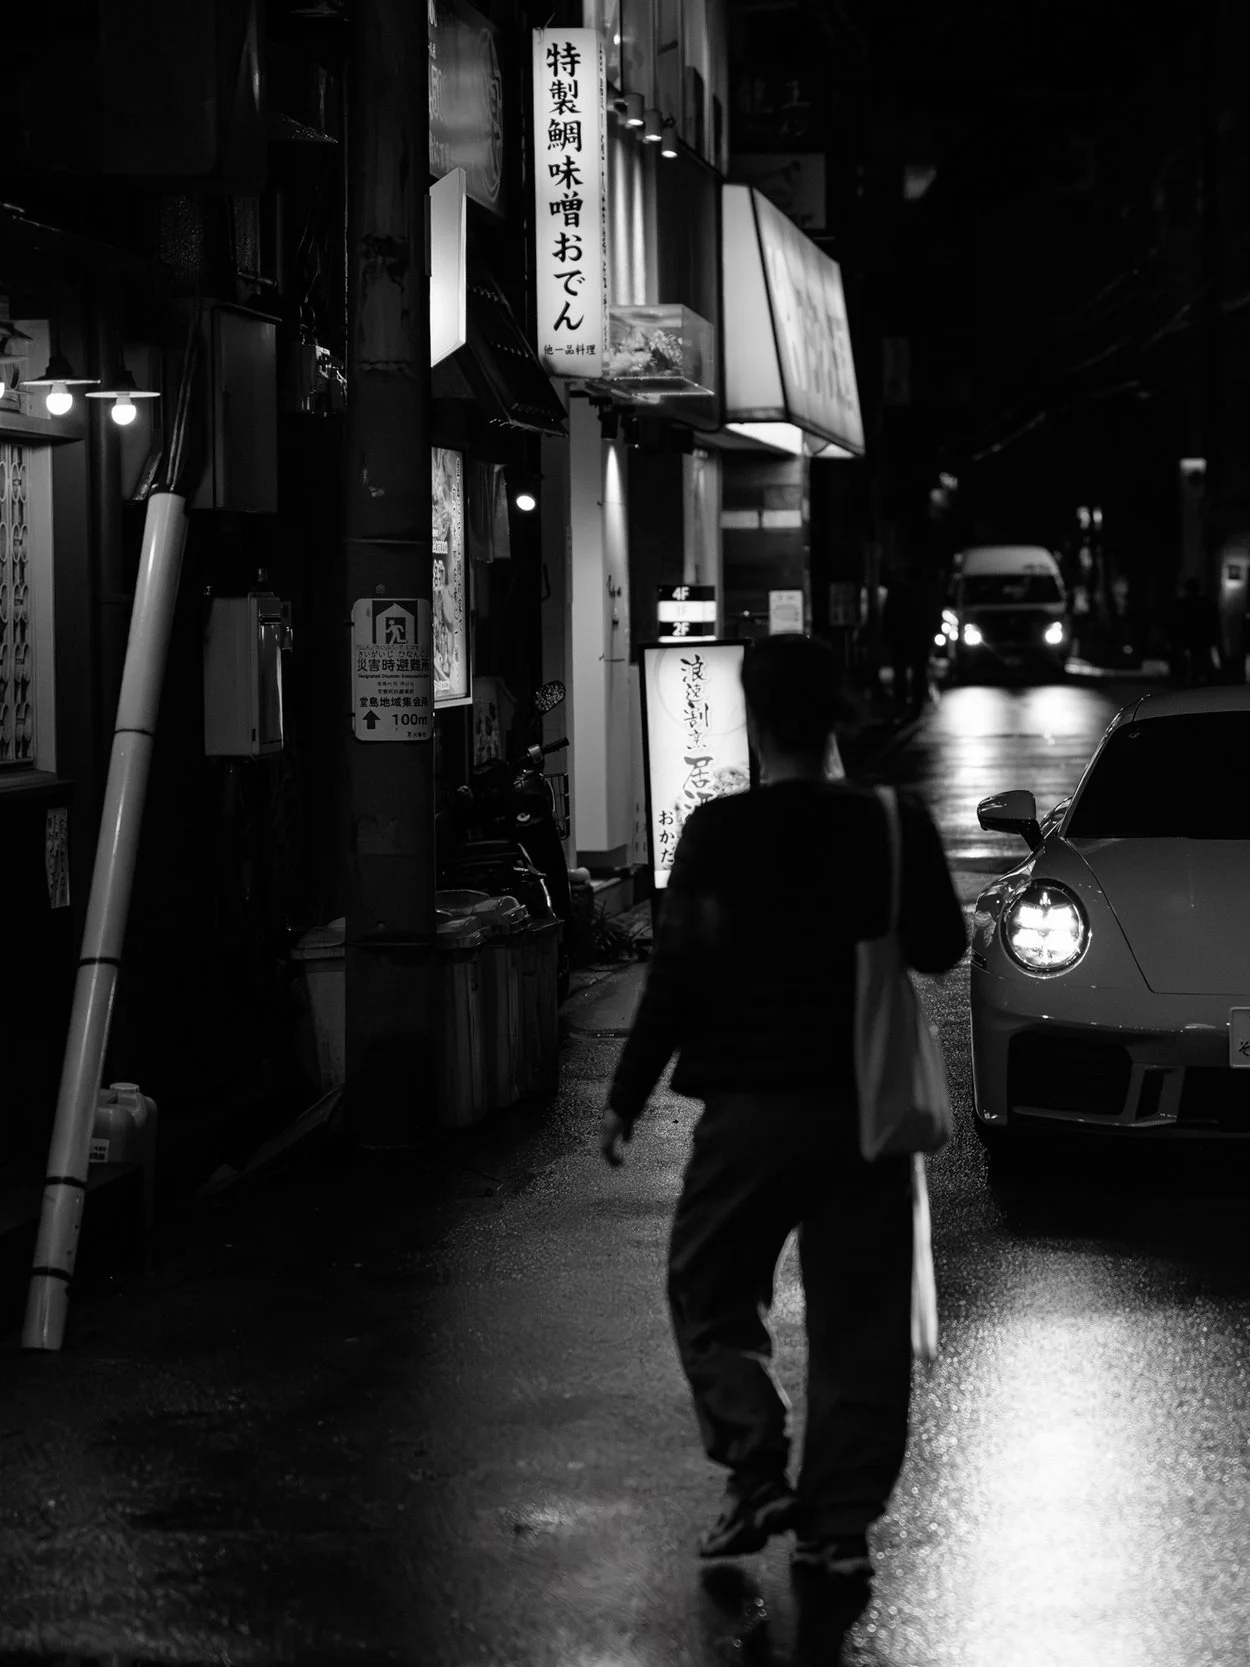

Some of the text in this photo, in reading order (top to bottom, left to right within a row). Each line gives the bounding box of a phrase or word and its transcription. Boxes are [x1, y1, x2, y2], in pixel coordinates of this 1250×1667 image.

[546, 41, 585, 332] 特製鯛味噌おでん
[672, 586, 691, 601] 4F
[672, 621, 691, 637] 2F
[357, 658, 430, 672] 災害時避難所
[392, 713, 427, 726] 100m
